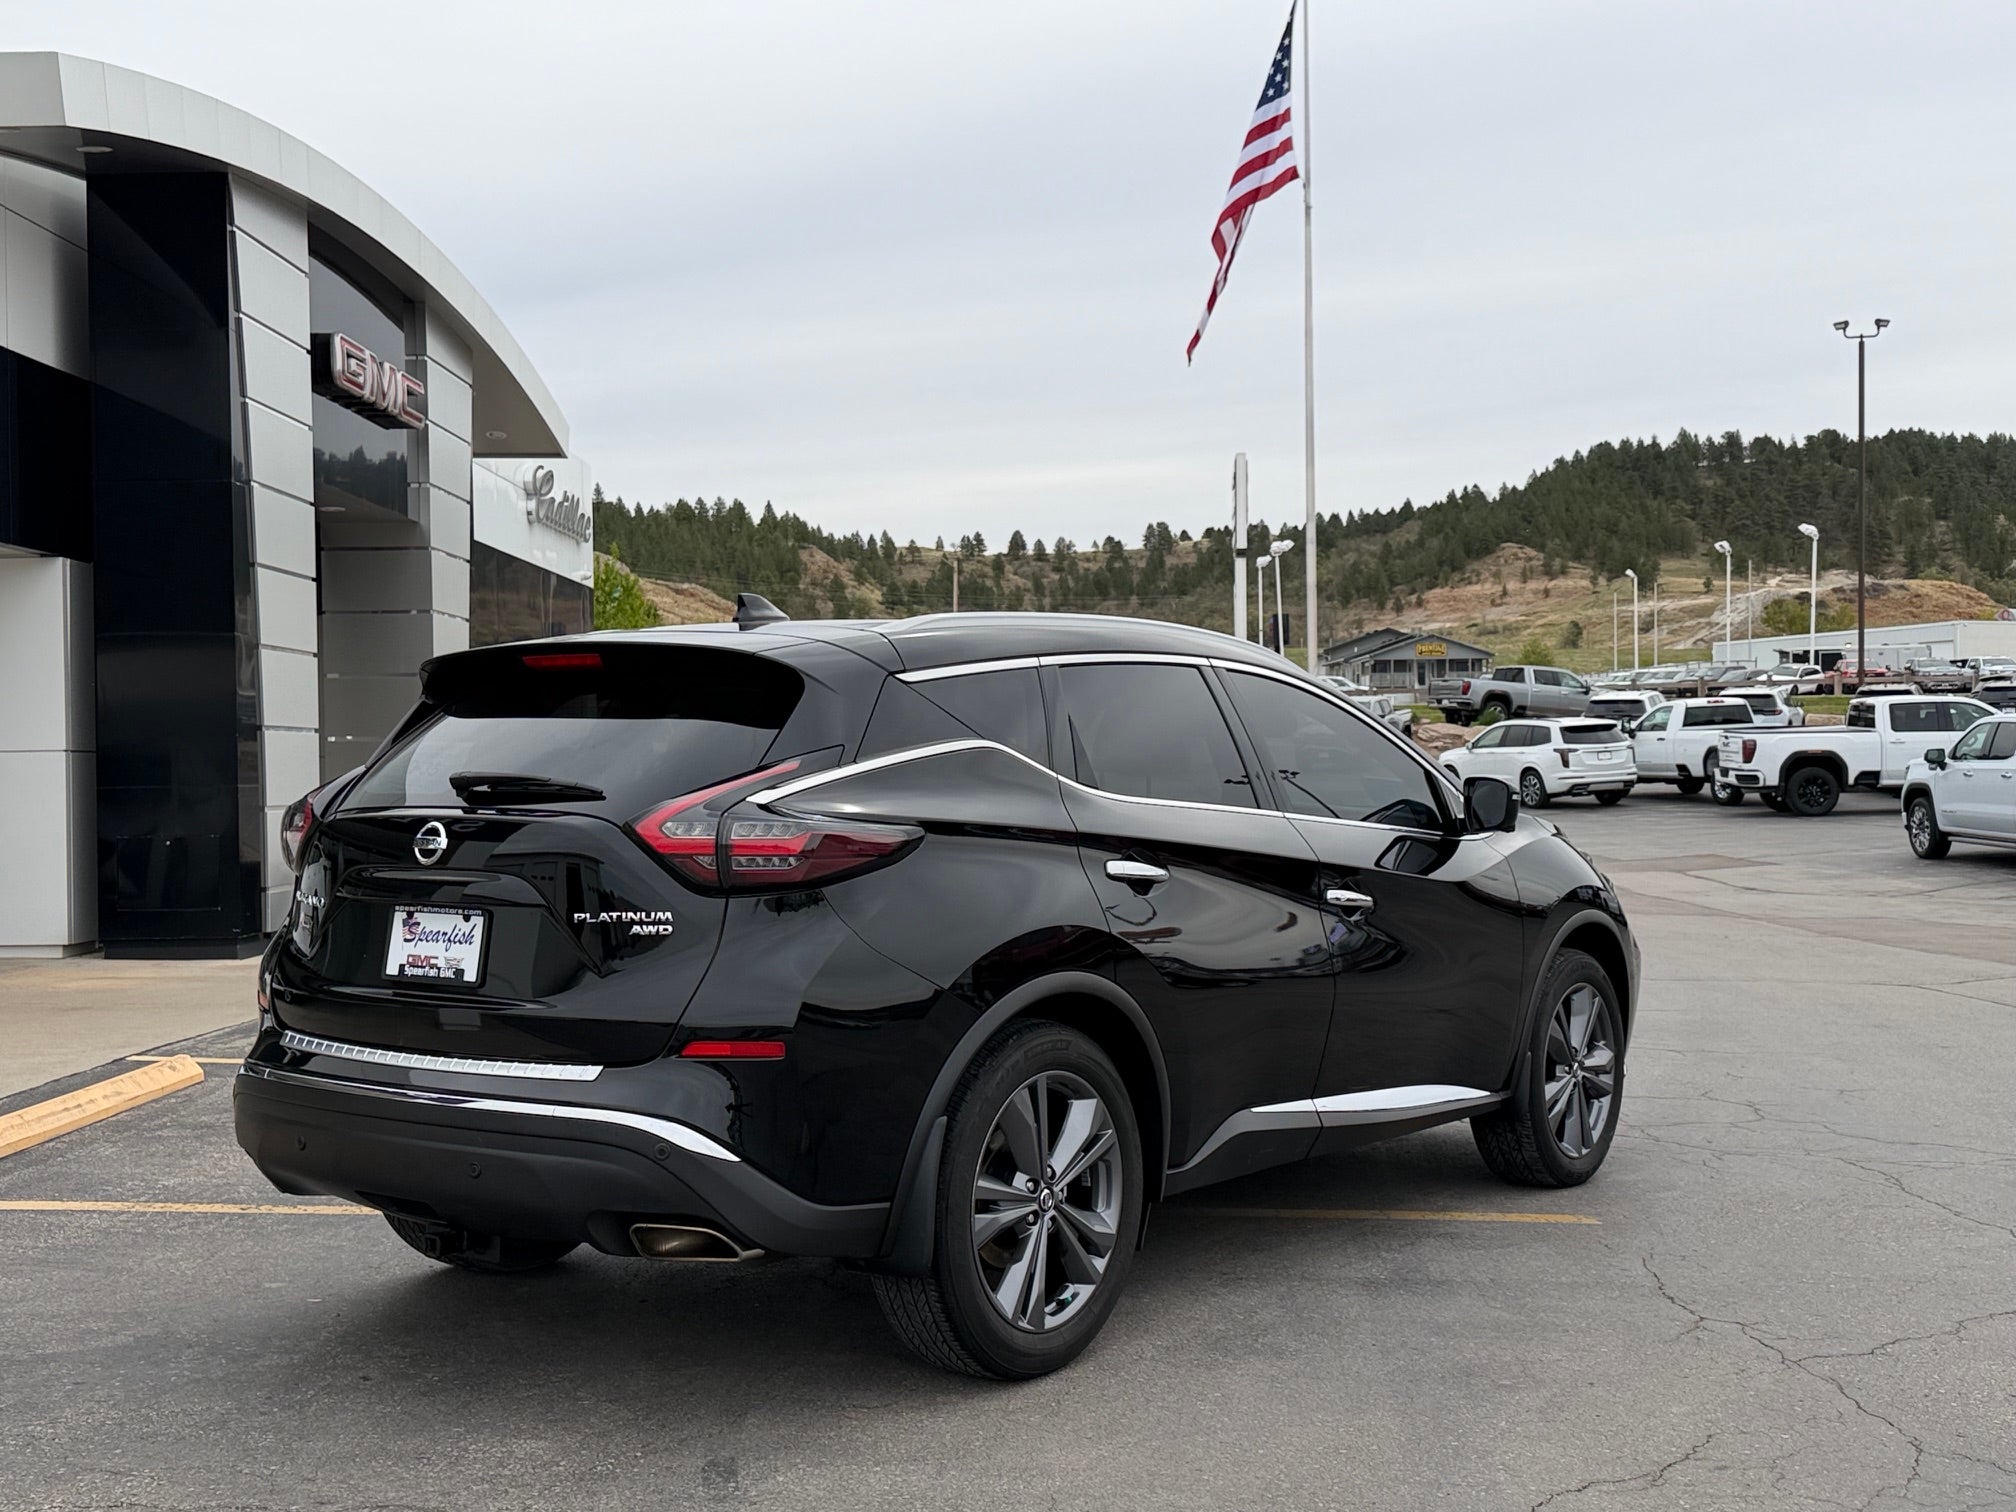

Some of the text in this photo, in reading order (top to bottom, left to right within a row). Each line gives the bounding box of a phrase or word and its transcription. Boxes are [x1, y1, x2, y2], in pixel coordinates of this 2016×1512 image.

[331, 332, 426, 430] GMC
[532, 465, 591, 543] Cadillac
[395, 905, 482, 916] spearfishmotors.com
[573, 911, 674, 923] PLATINUM
[403, 921, 477, 952] Spearfish
[628, 925, 674, 936] AWD
[406, 954, 439, 967] GMC
[404, 965, 456, 979] Spearfish GMC
